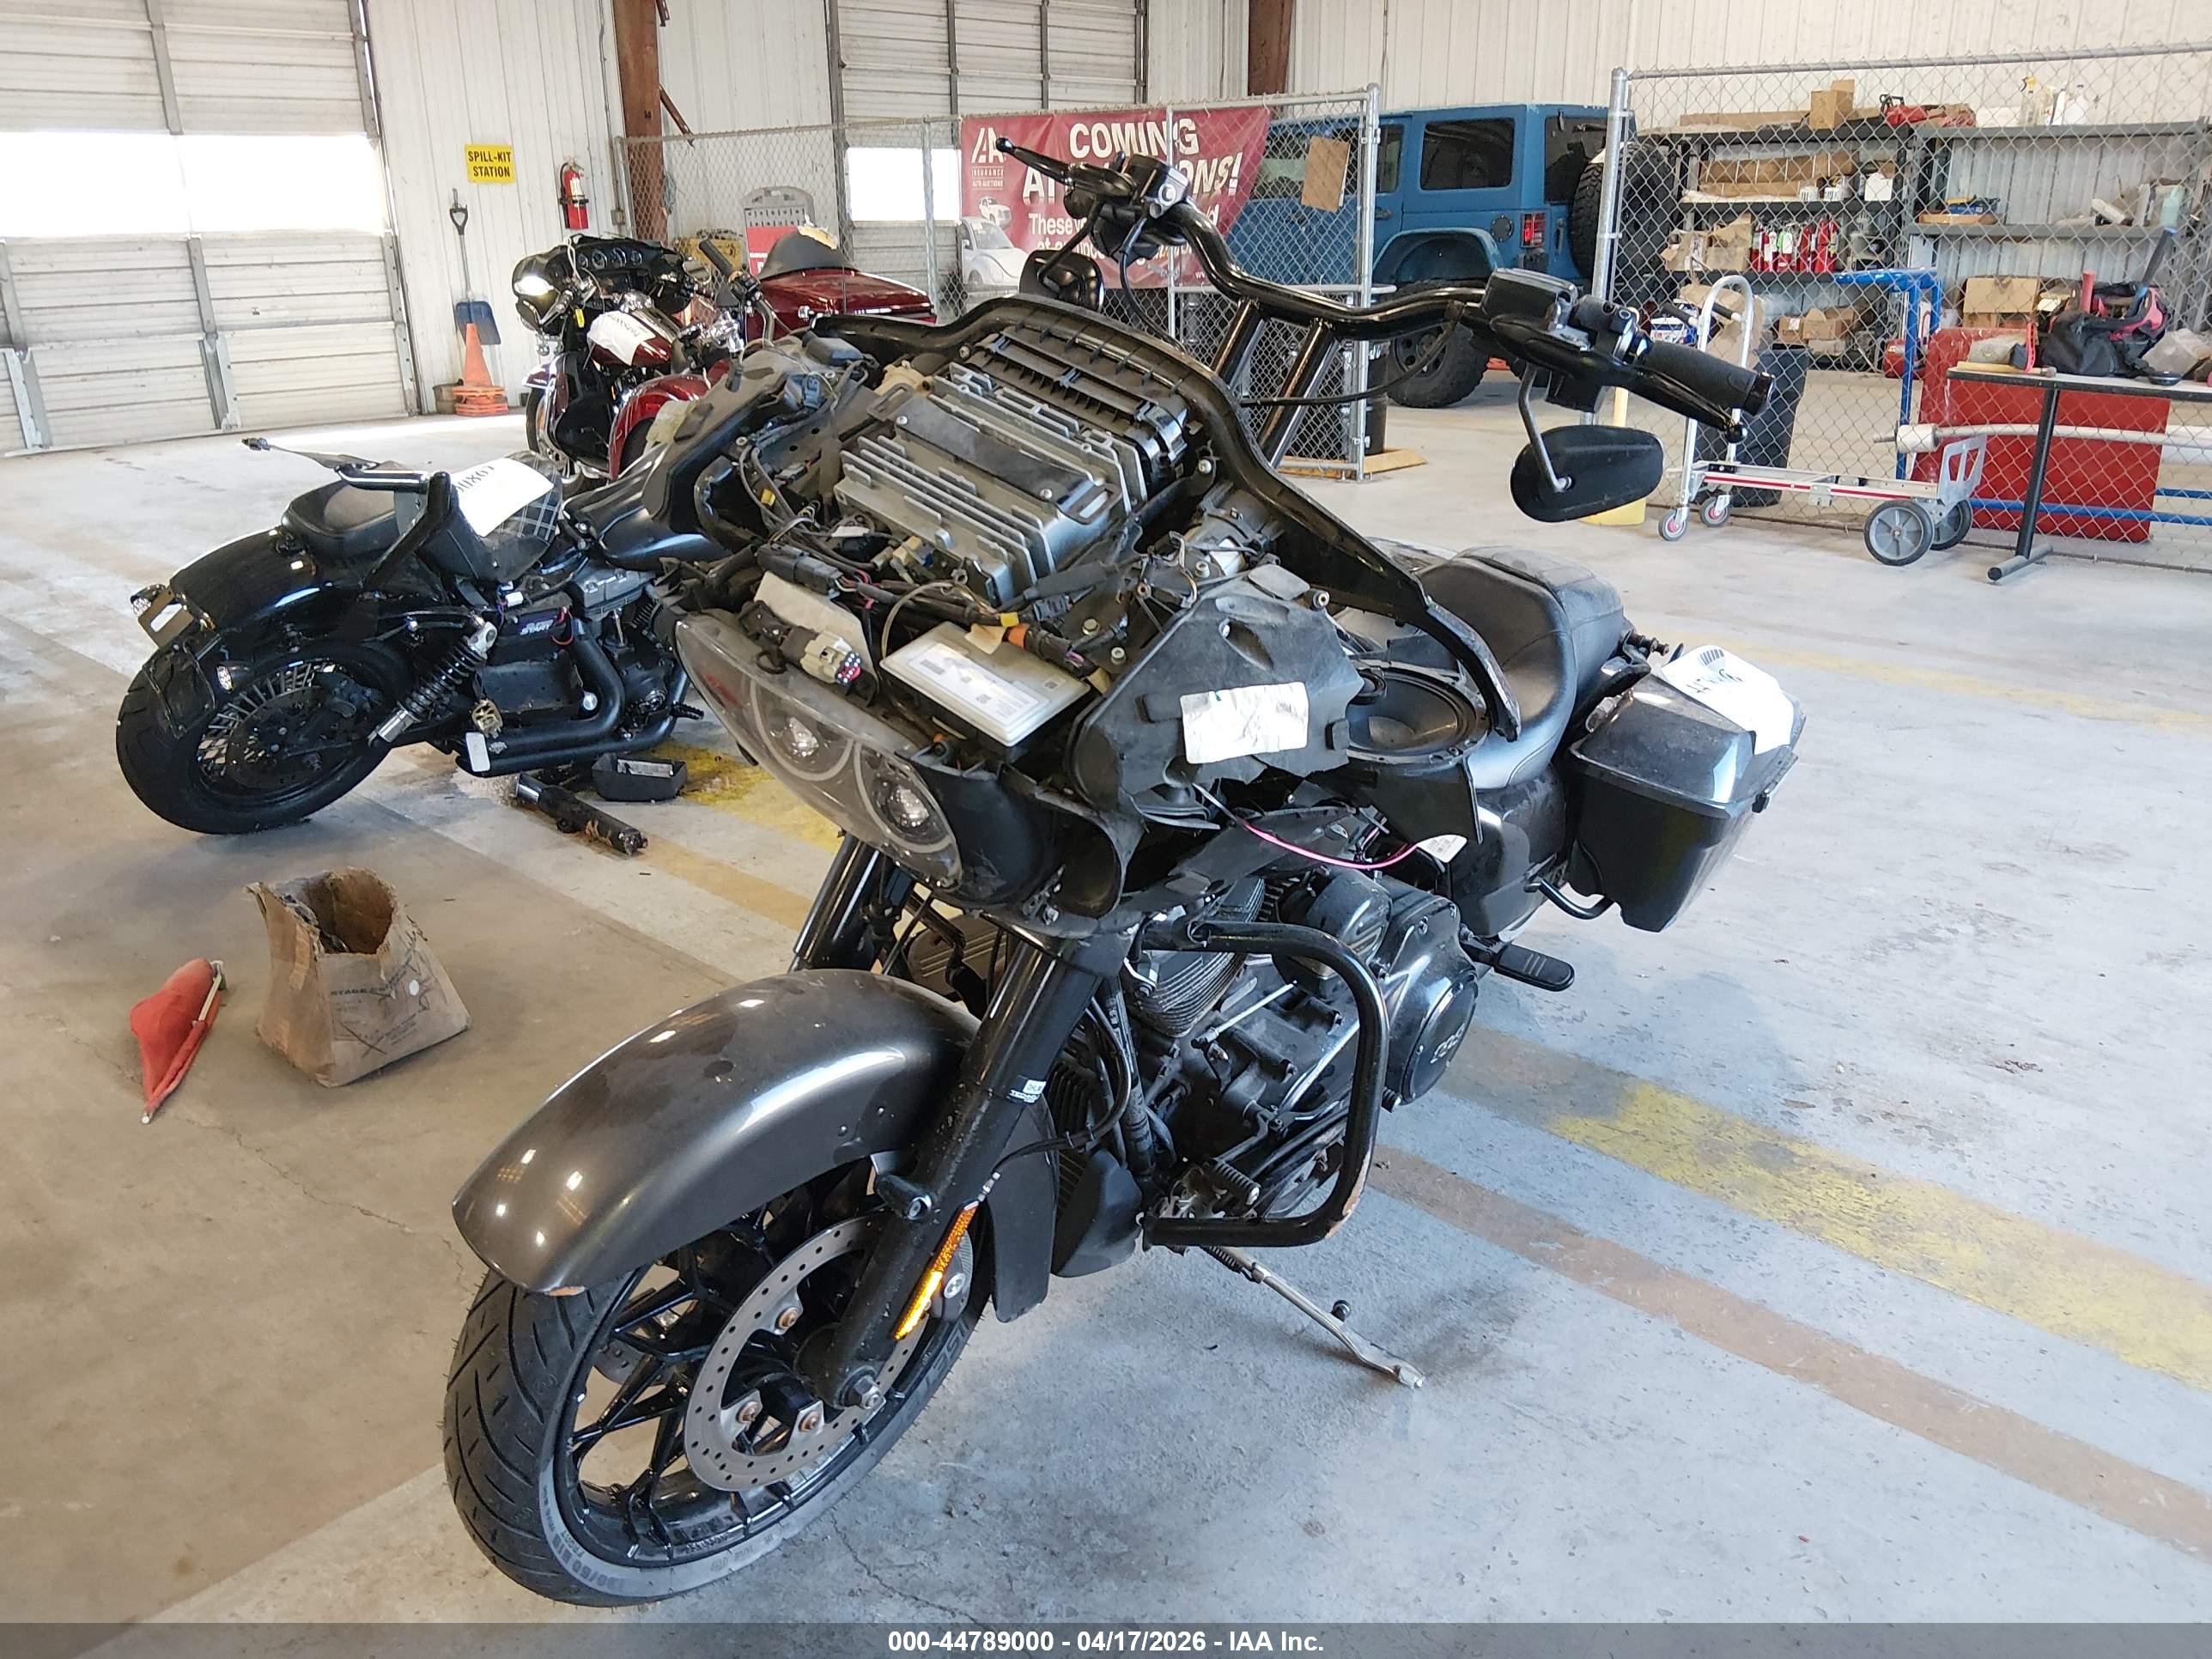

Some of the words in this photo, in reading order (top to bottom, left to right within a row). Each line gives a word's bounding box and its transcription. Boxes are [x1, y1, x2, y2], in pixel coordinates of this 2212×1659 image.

[1069, 118, 1200, 158] COMING
[468, 150, 512, 163] SPILL-KIT
[473, 166, 511, 178] STATION
[1028, 212, 1073, 235] These
